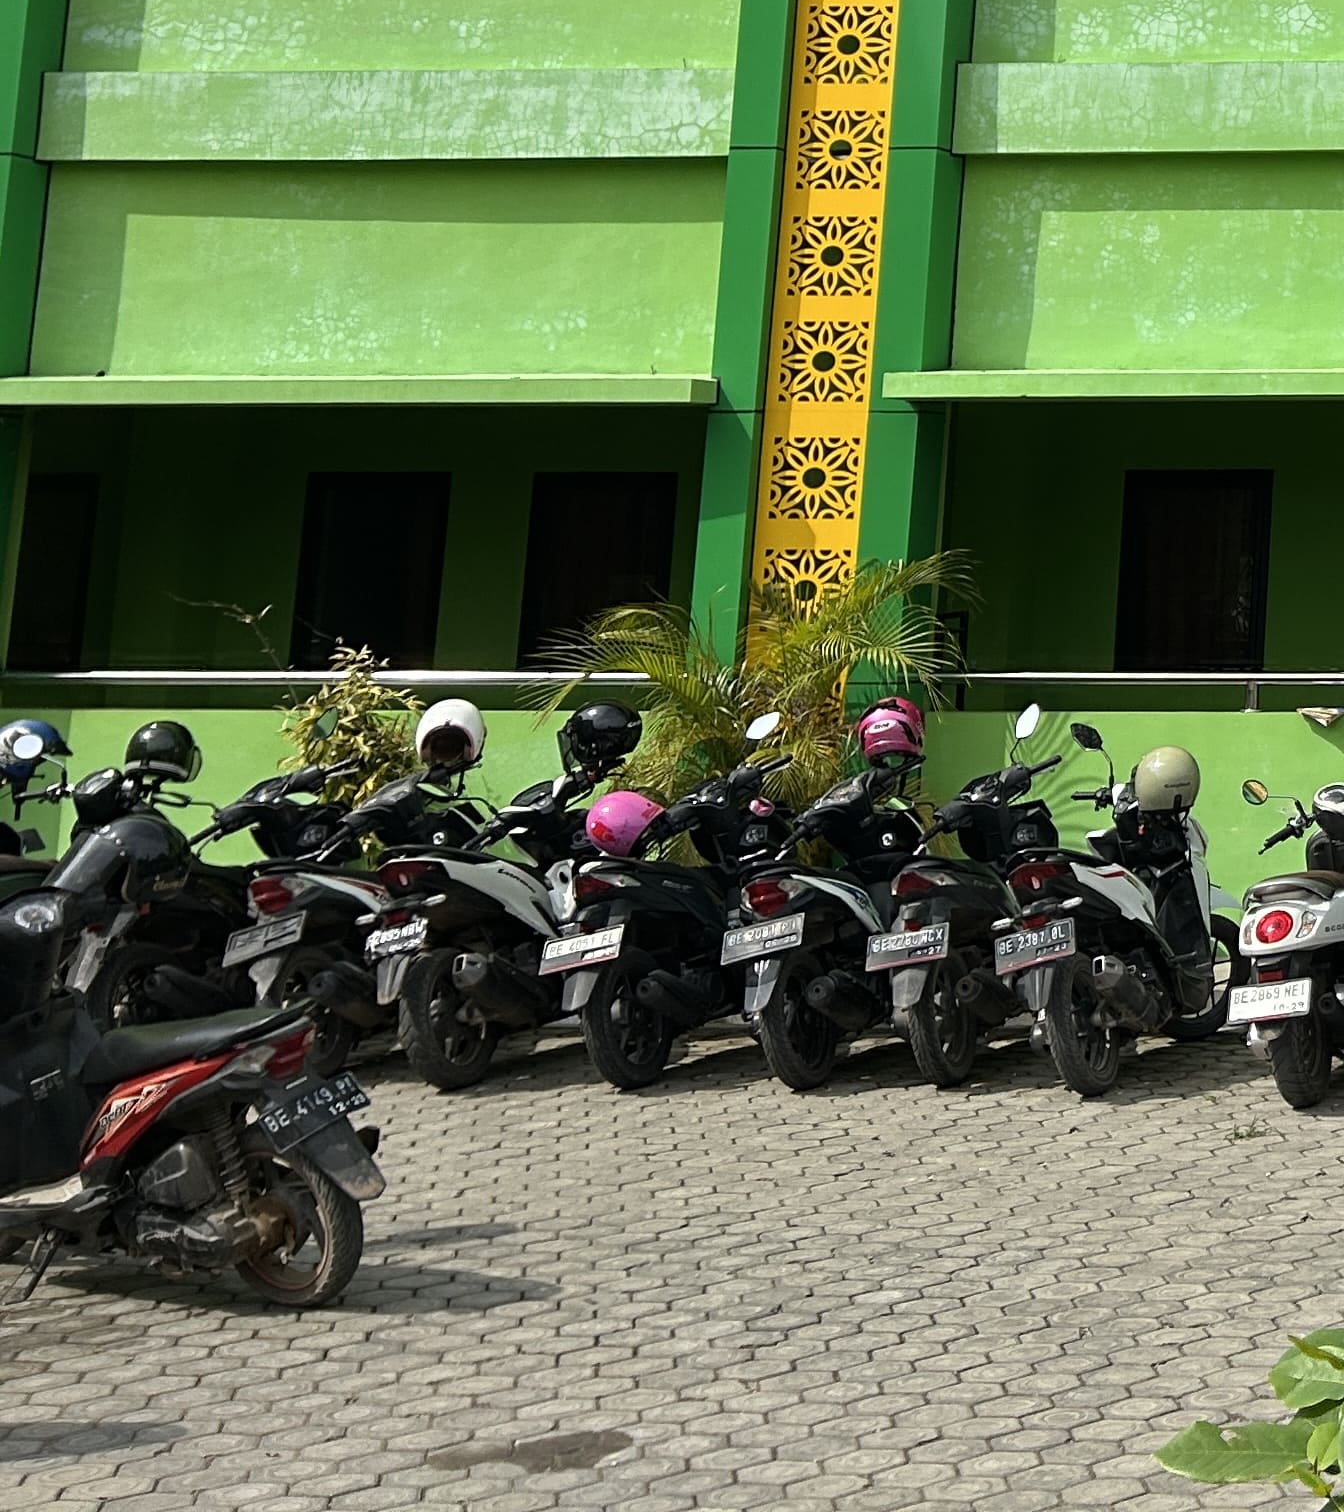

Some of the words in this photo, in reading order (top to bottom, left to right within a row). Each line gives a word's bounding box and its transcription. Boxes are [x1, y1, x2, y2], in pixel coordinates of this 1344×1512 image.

[999, 939, 1014, 956] BE
[1017, 931, 1046, 950] 2387
[1234, 990, 1249, 1005] BE
[264, 1108, 291, 1133] BE
